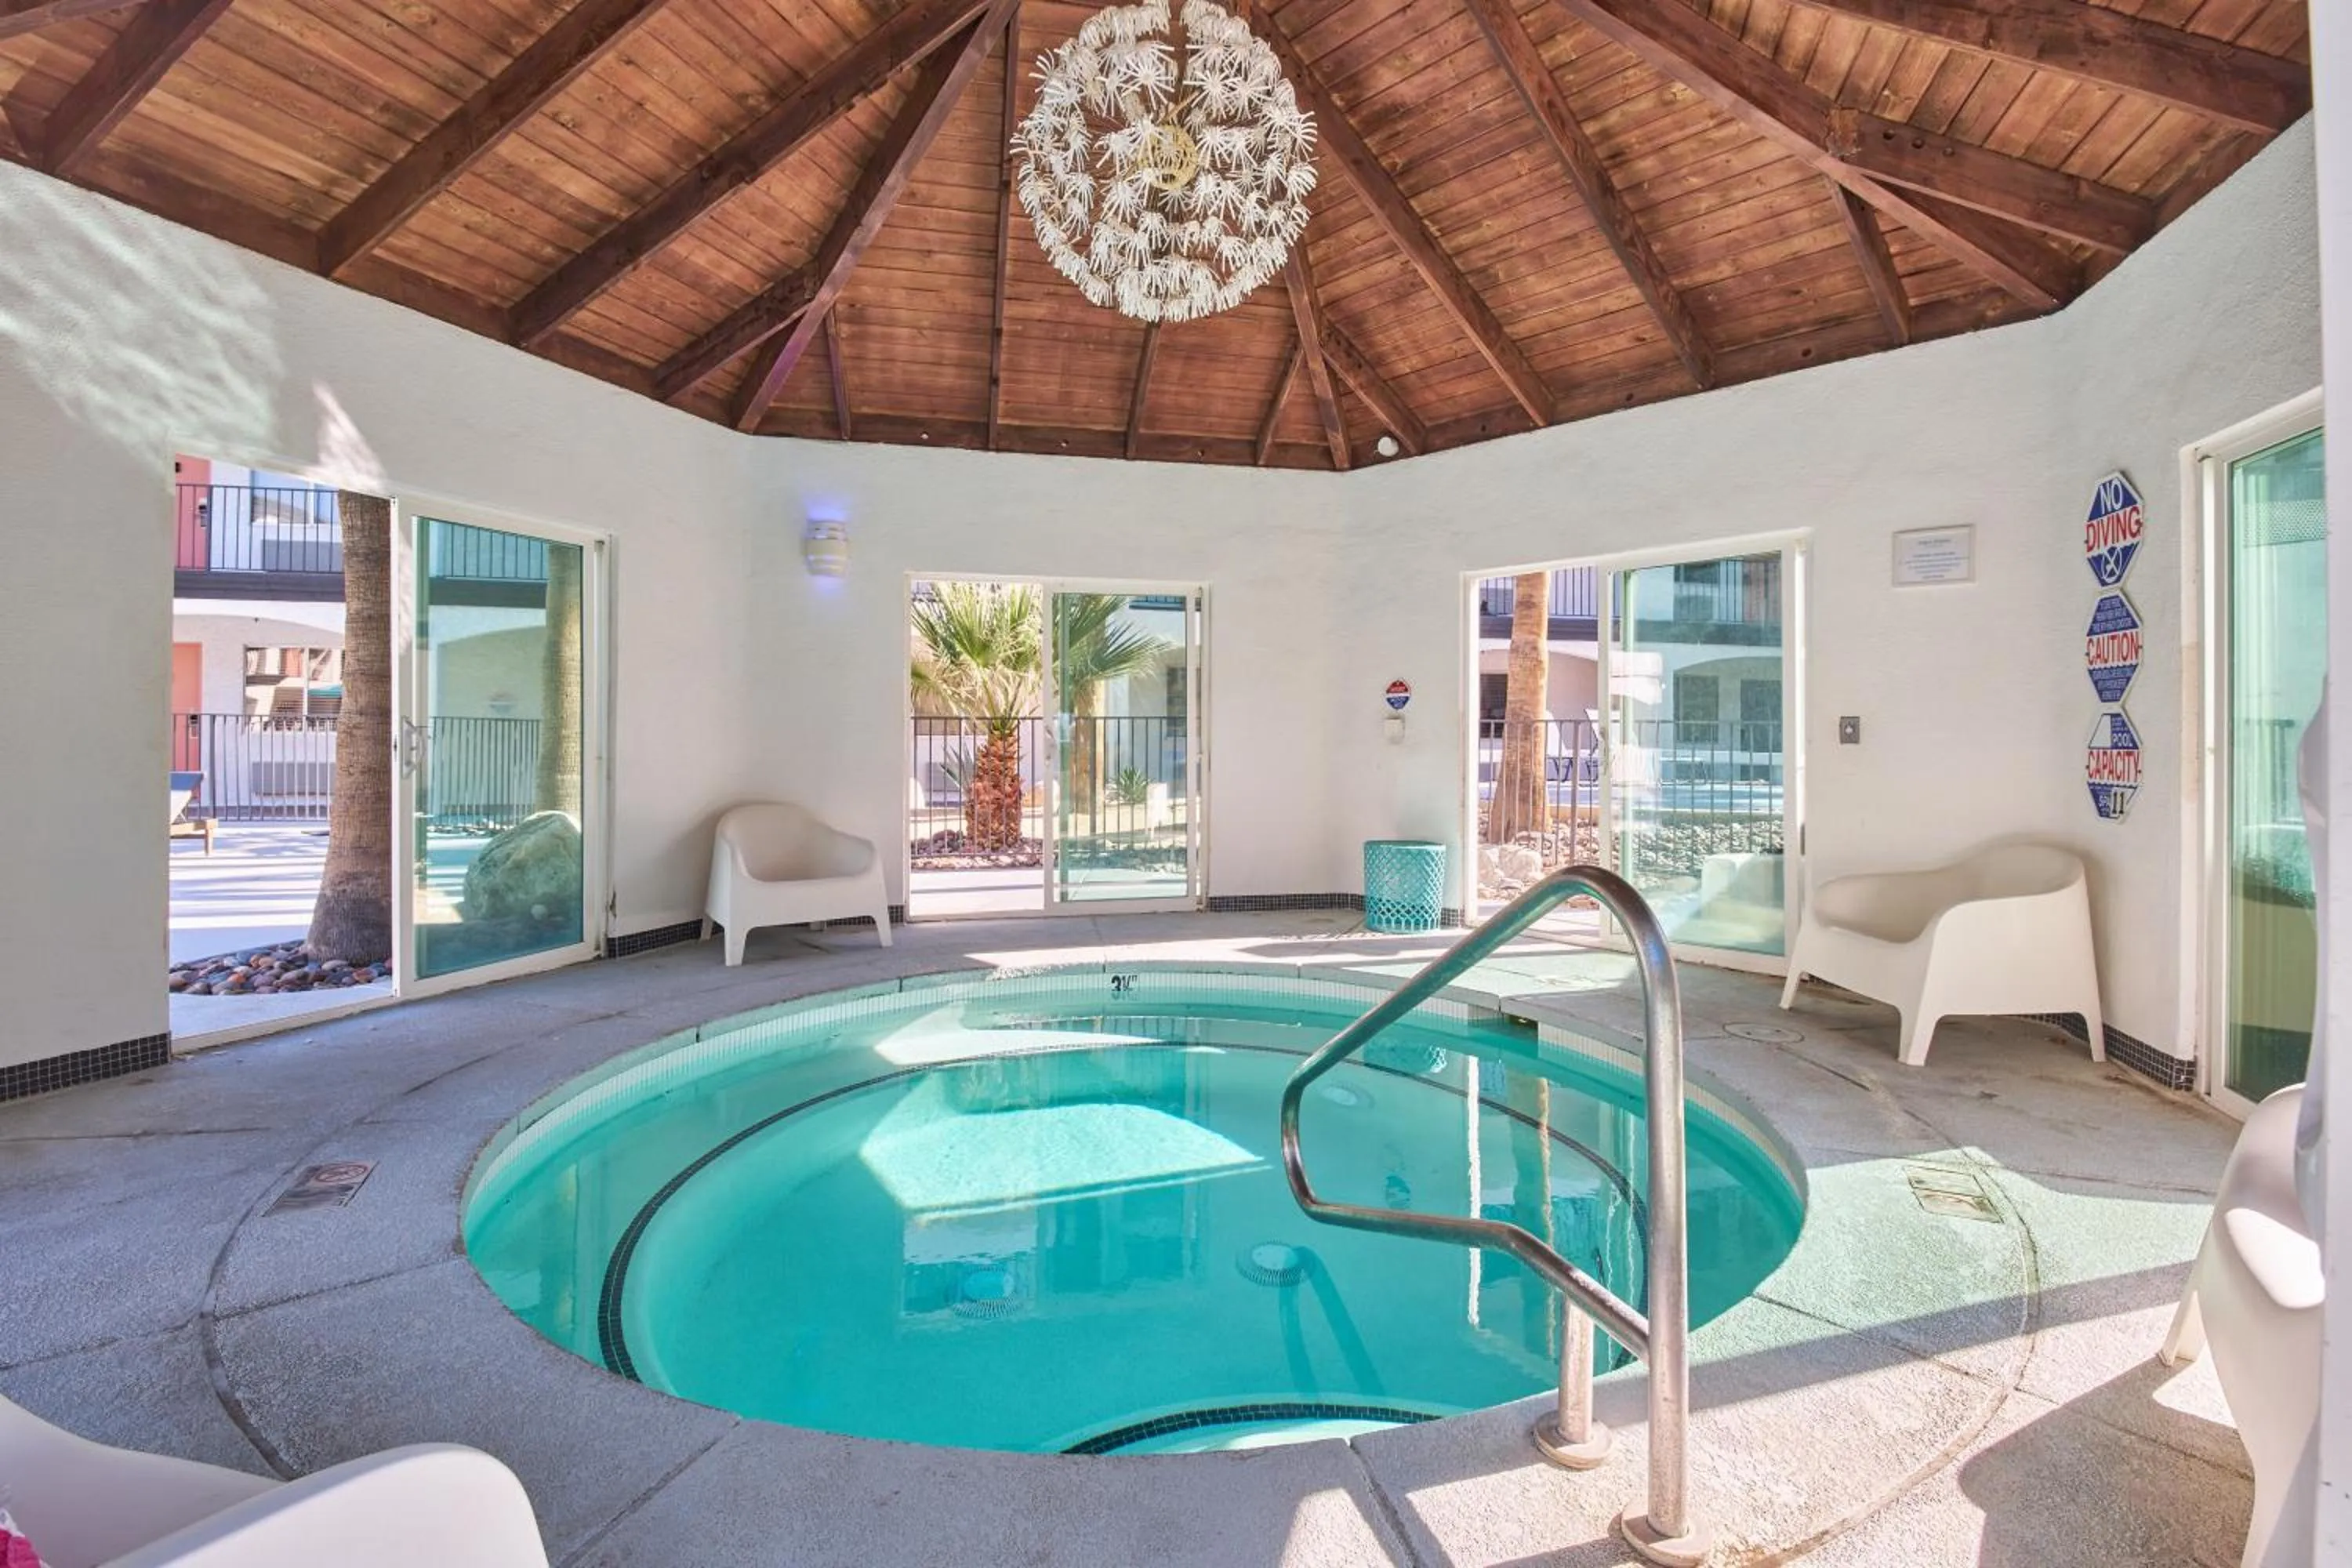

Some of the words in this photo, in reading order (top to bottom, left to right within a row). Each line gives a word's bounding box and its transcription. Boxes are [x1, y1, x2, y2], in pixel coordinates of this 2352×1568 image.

[2099, 478, 2123, 515] NO
[2086, 506, 2141, 553] DIVING
[2086, 630, 2139, 666] CAUTION
[2112, 732, 2133, 748] POOL
[2088, 750, 2140, 783] CAPACITY
[2111, 791, 2125, 815] 11
